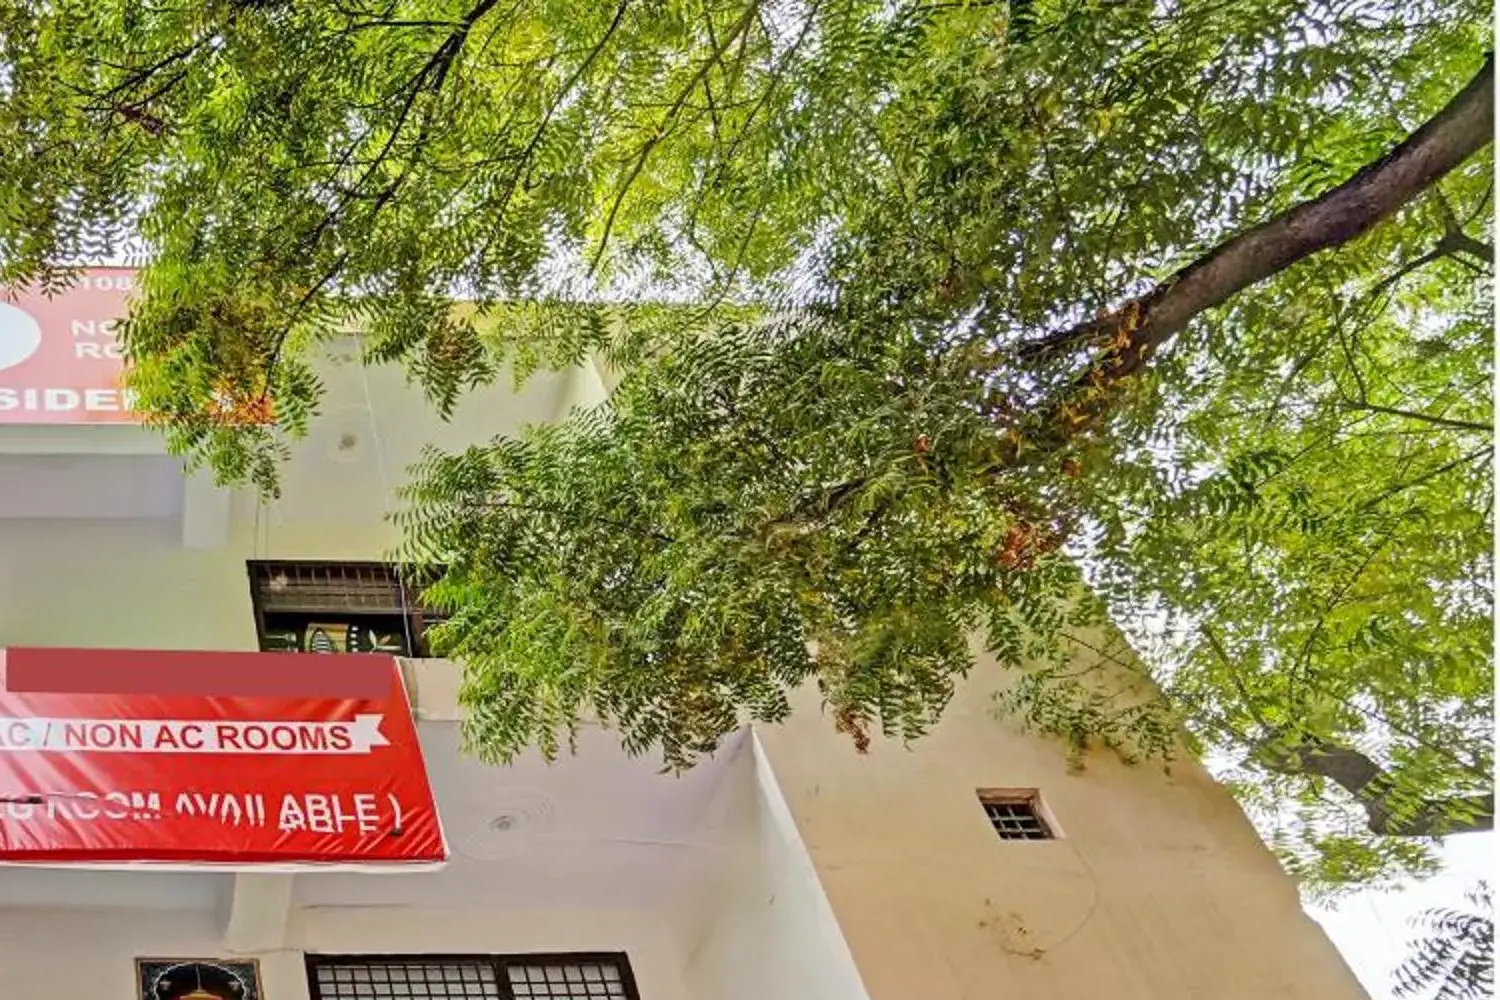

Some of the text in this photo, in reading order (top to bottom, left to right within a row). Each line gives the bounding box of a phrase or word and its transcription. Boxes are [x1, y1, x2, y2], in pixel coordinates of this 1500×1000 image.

[64, 723, 144, 749] NON
[153, 724, 204, 749] AC
[216, 724, 353, 751] ROOMS
